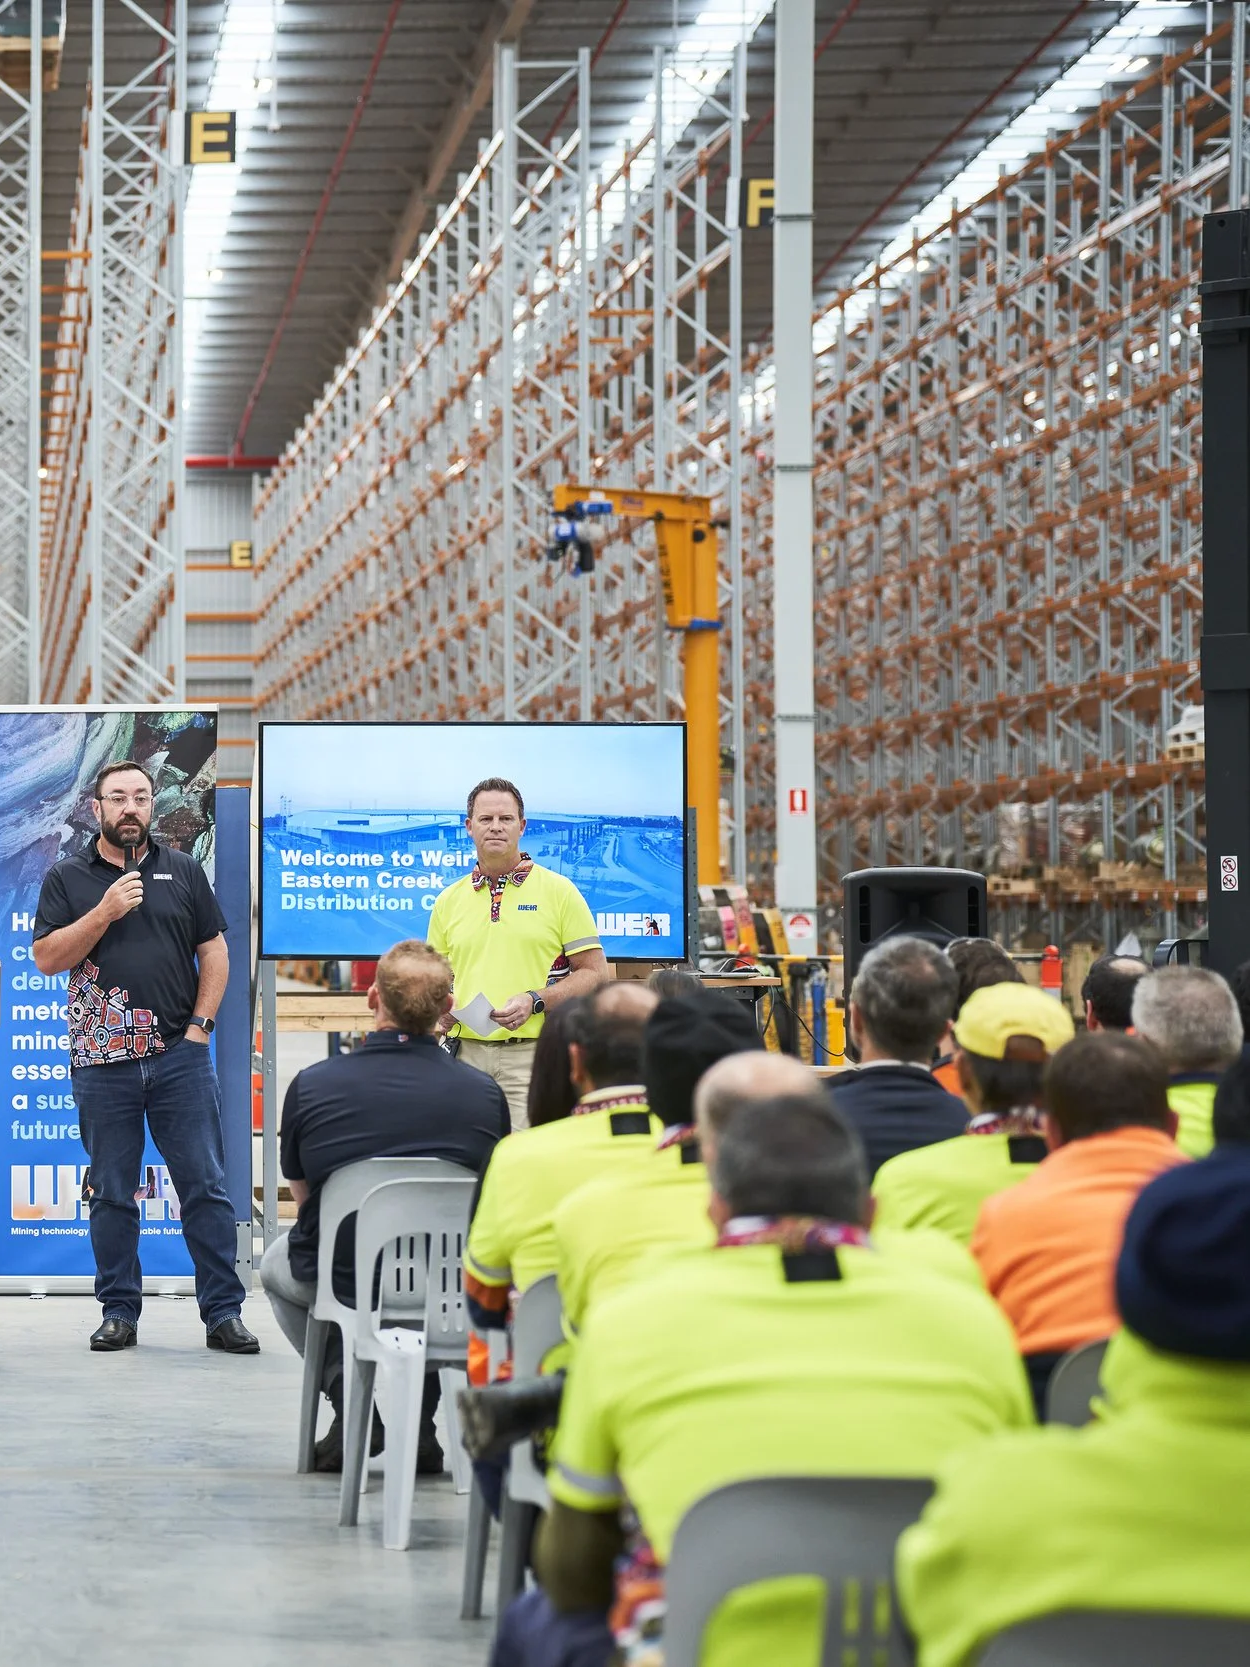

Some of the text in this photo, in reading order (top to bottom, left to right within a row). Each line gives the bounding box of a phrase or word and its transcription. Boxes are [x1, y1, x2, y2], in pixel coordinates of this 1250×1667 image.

[191, 112, 231, 164] E
[746, 179, 775, 228] F
[231, 540, 252, 568] E
[280, 850, 384, 866] Welcome
[391, 852, 414, 866] to
[281, 872, 445, 888] Eastern Creek
[281, 893, 413, 910] Distribution
[596, 913, 671, 937] WEIR
[12, 1095, 28, 1110] a
[11, 1228, 39, 1237] Mining
[41, 1227, 89, 1237] technology
